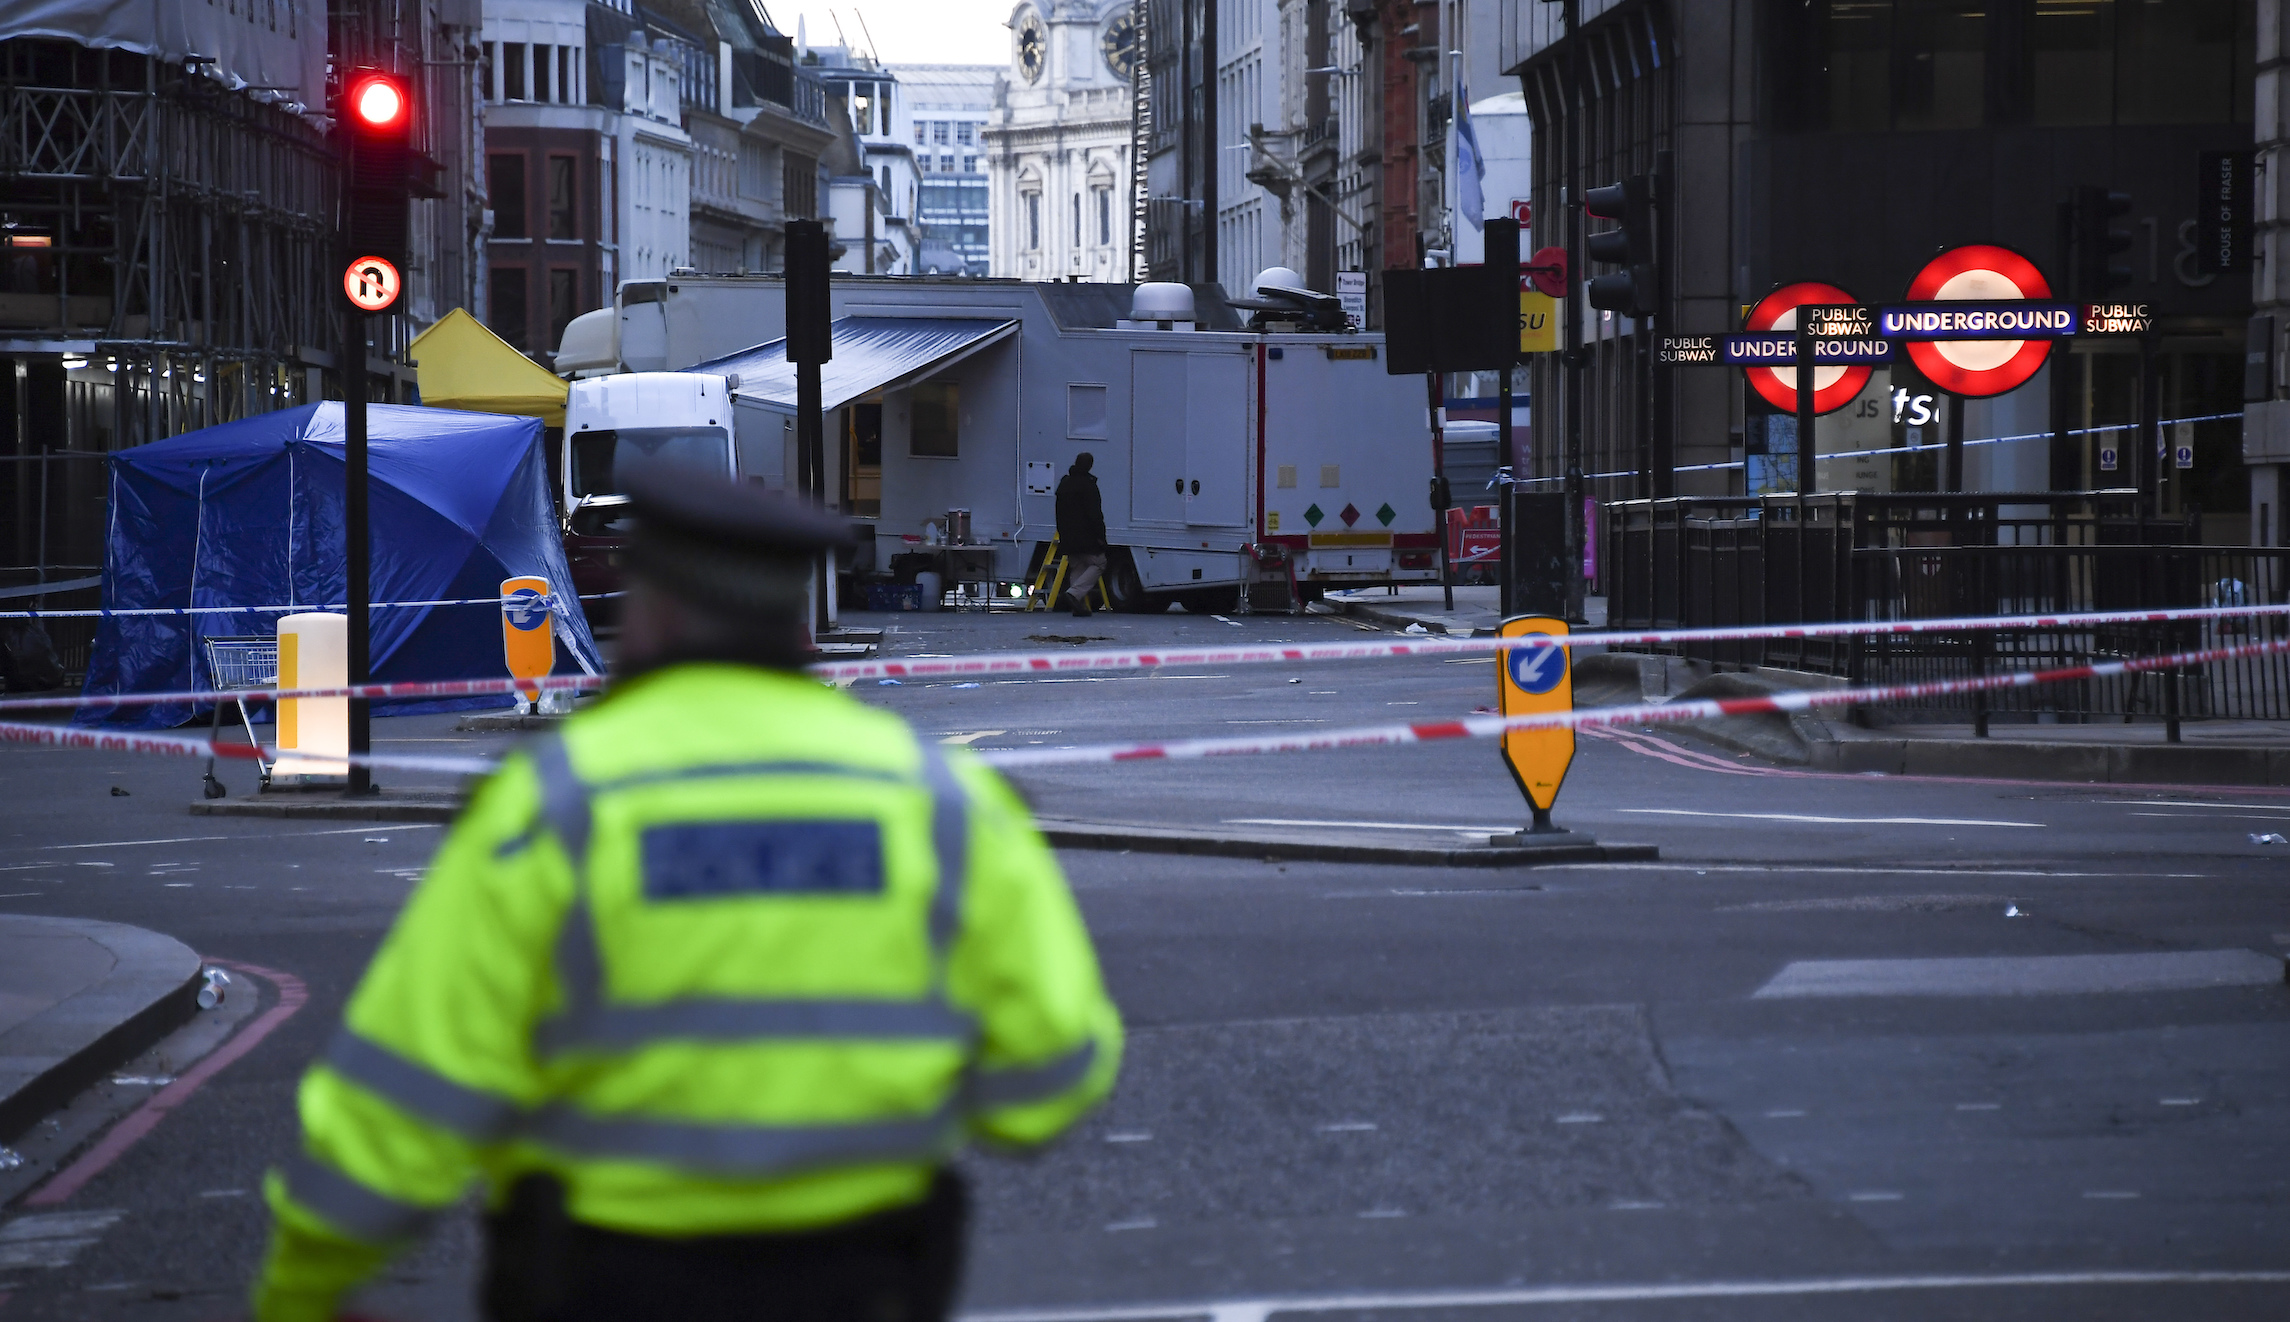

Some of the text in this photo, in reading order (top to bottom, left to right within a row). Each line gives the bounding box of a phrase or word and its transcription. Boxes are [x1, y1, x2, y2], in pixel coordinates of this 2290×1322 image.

[2221, 157, 2232, 267] HOUSE OF FRASER
[1812, 307, 1868, 321] PUBLIC
[2091, 304, 2148, 317] PUBLIC
[1886, 310, 2072, 331] UNDERGROUND
[2086, 318, 2153, 333] SUBWAY
[1807, 321, 1872, 337] SUBWAY
[1663, 337, 1712, 350] PUBLIC
[1730, 340, 1889, 358] UNDERROUND
[1659, 349, 1716, 363] SUBWAY
